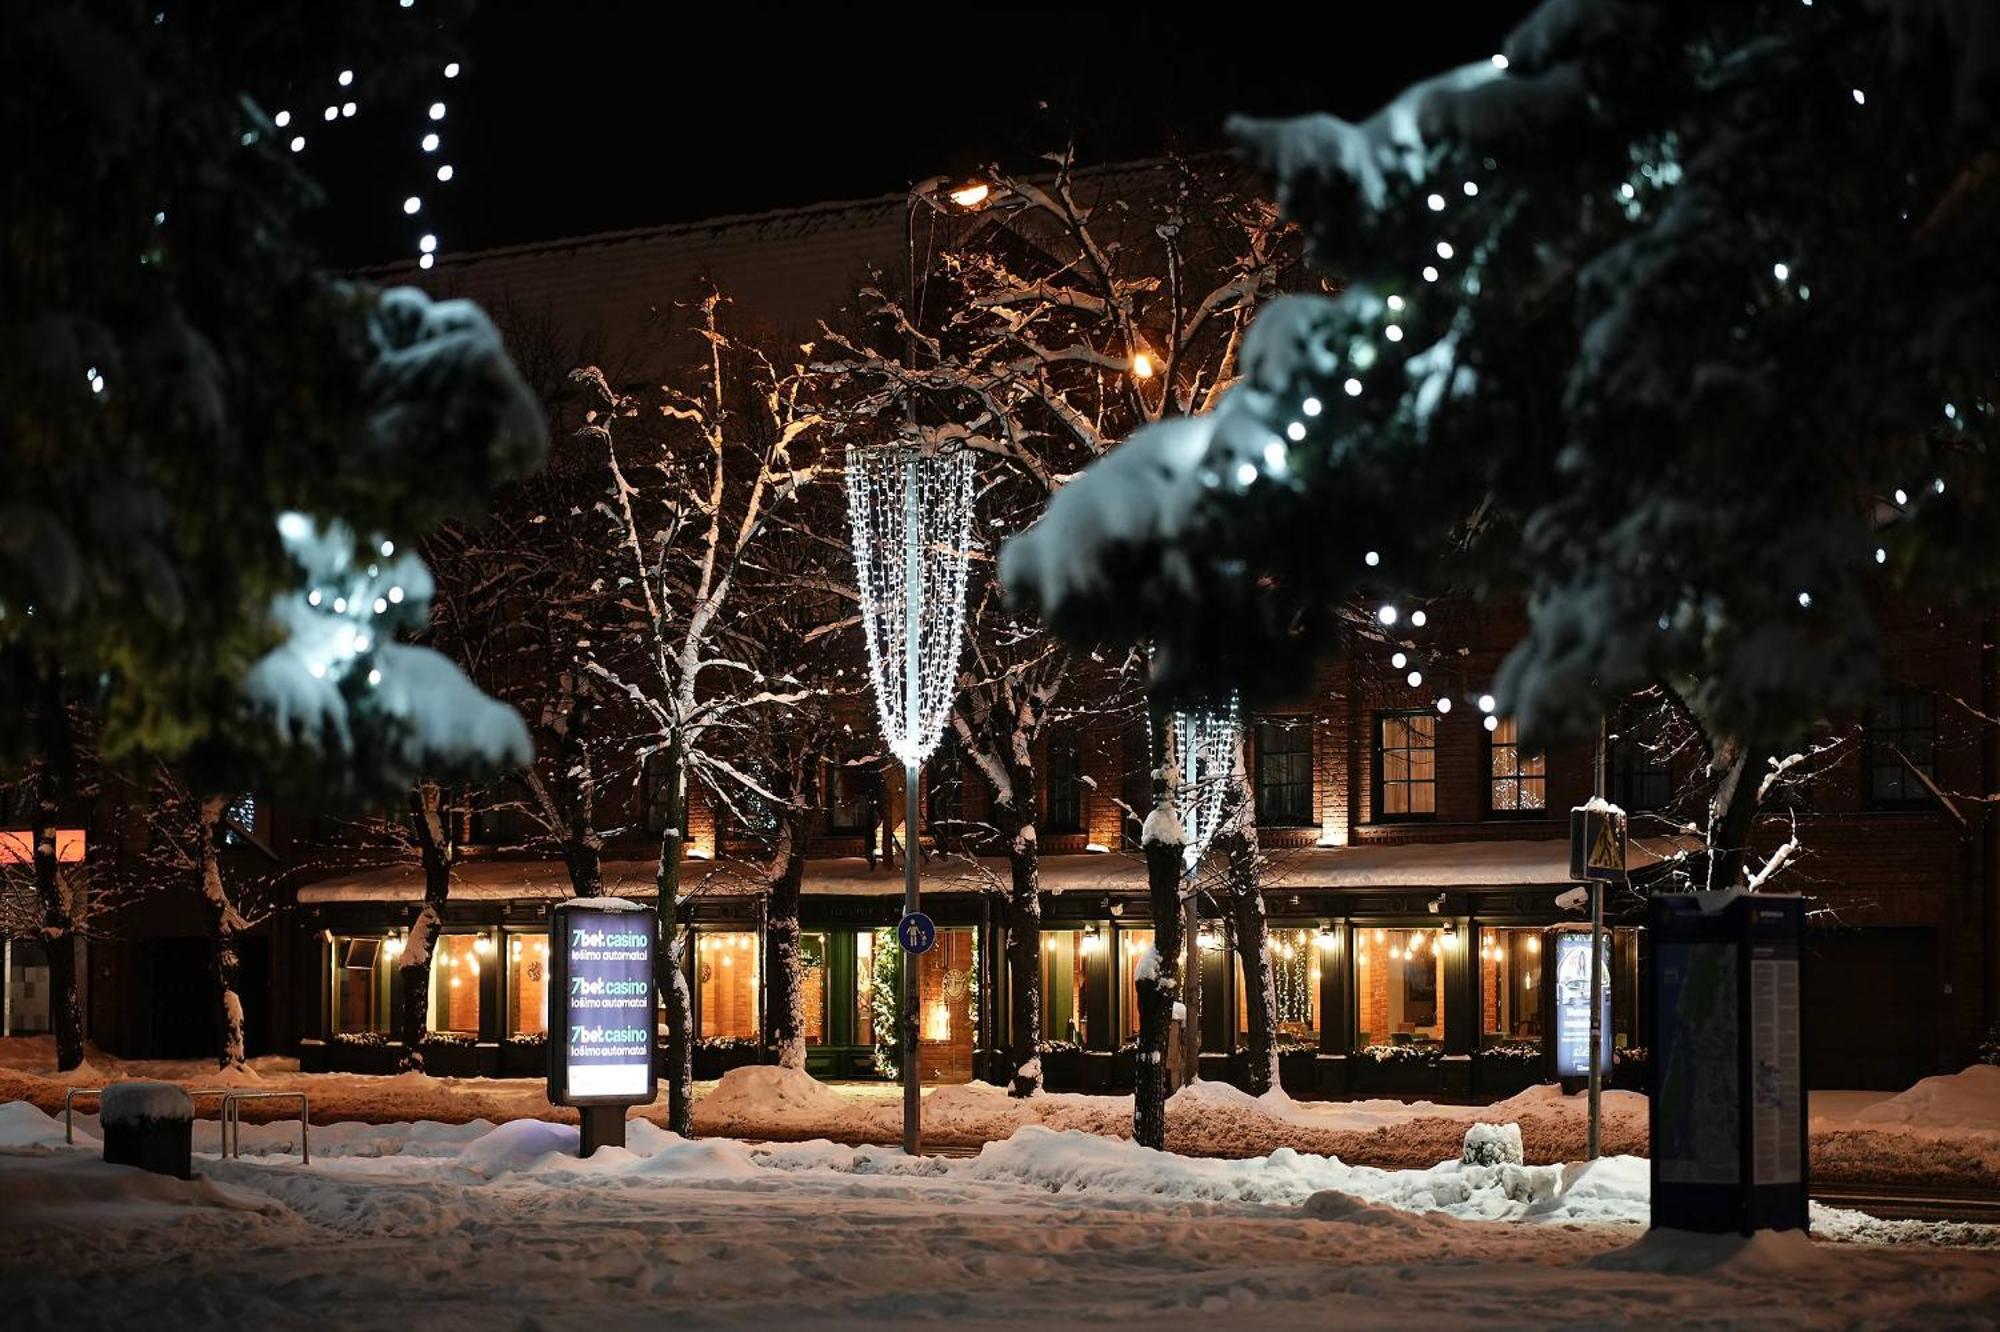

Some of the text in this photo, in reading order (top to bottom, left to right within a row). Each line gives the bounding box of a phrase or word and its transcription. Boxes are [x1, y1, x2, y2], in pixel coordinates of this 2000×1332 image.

[607, 930, 648, 947] casino
[606, 977, 648, 994] casino
[605, 1025, 647, 1042] casino
